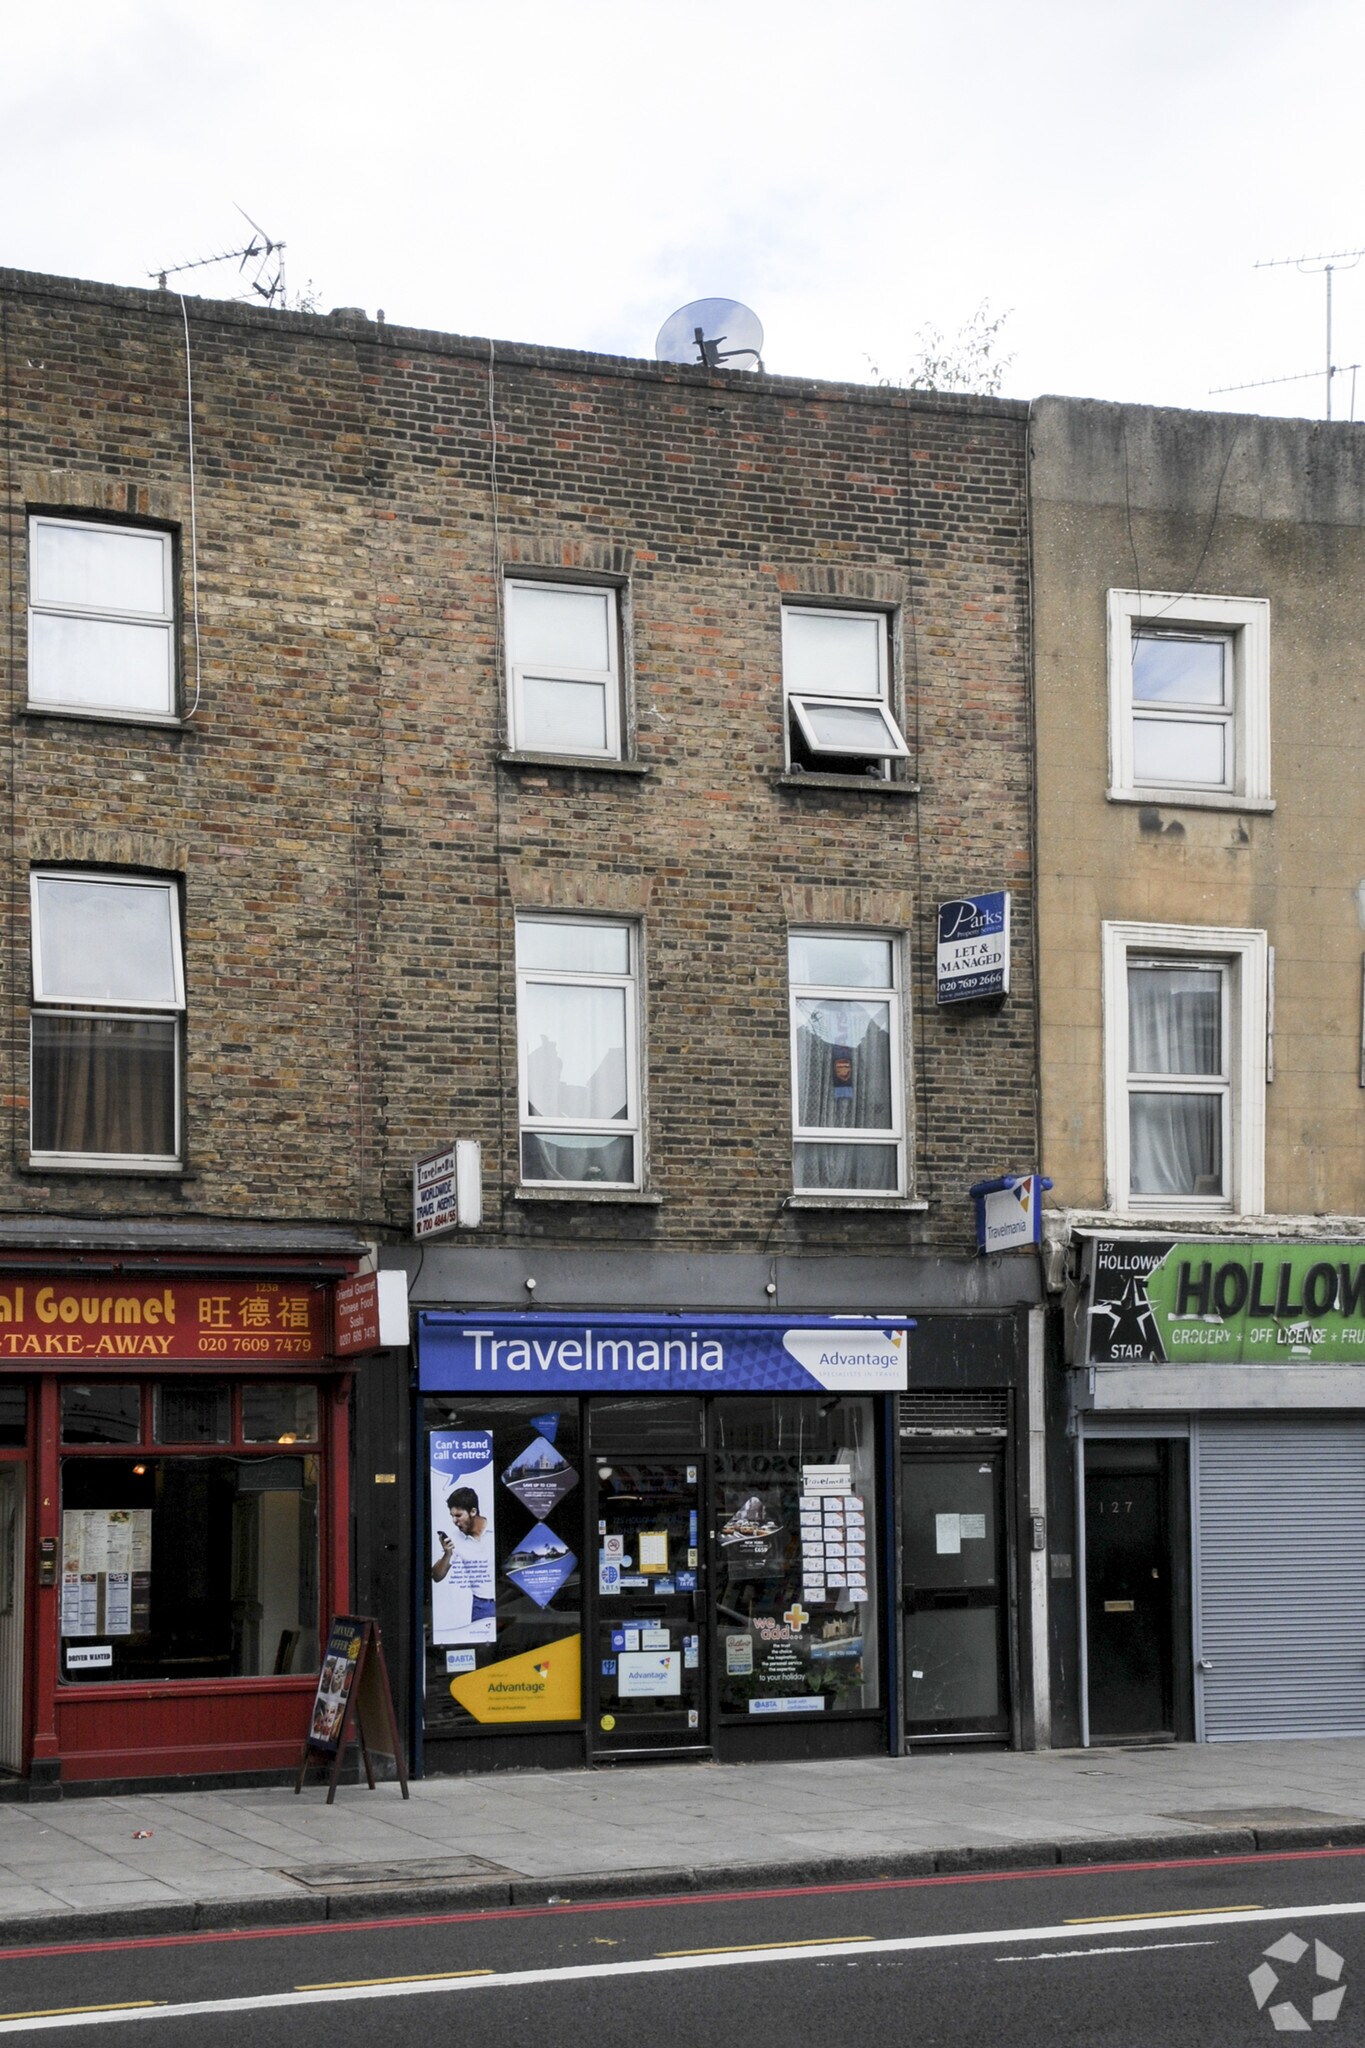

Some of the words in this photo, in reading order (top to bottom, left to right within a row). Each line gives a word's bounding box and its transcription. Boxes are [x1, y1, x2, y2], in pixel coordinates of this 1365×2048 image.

[939, 900, 1003, 938] Parks
[955, 945, 977, 959] LET
[979, 943, 989, 954] &
[940, 952, 1002, 973] MANAGED
[940, 981, 957, 992] 020
[958, 977, 978, 989] 7619
[979, 972, 1002, 986] 2666
[420, 1180, 452, 1202] WORLDWIDE
[416, 1202, 435, 1220] TRAVEL
[436, 1194, 456, 1213] AGENTS
[422, 1217, 433, 1232] 700
[987, 1220, 1027, 1239] Travelmania
[1099, 1243, 1114, 1252] 127
[256, 1282, 280, 1293] 123a
[354, 1280, 376, 1295] Gourmet
[35, 1287, 176, 1325] Gourmet
[198, 1296, 311, 1328] 旺德福
[340, 1302, 359, 1316] Chinese
[360, 1294, 374, 1309] Food
[350, 1313, 364, 1328] Sushi
[3, 1333, 175, 1355] TAKE-AWAY
[1172, 1328, 1232, 1345] GROCERY
[1250, 1328, 1274, 1345] OFF
[198, 1337, 228, 1352] 020
[232, 1337, 270, 1352] 7609
[275, 1337, 312, 1352] 7479
[462, 1329, 724, 1372] Travelmania
[1110, 1343, 1143, 1359] STAR
[819, 1351, 899, 1369] Advantage
[435, 1440, 459, 1449] Can't
[462, 1439, 488, 1449] stand
[433, 1450, 450, 1459] call
[452, 1449, 491, 1459] centres?
[1100, 1501, 1133, 1513] 127
[753, 1617, 776, 1630] we
[68, 1654, 88, 1662] DRIVER
[455, 1654, 474, 1663] ABTA
[628, 1671, 668, 1680] Advantage
[767, 1674, 781, 1682] your
[782, 1672, 805, 1682] holiday
[488, 1681, 546, 1693] Advantage
